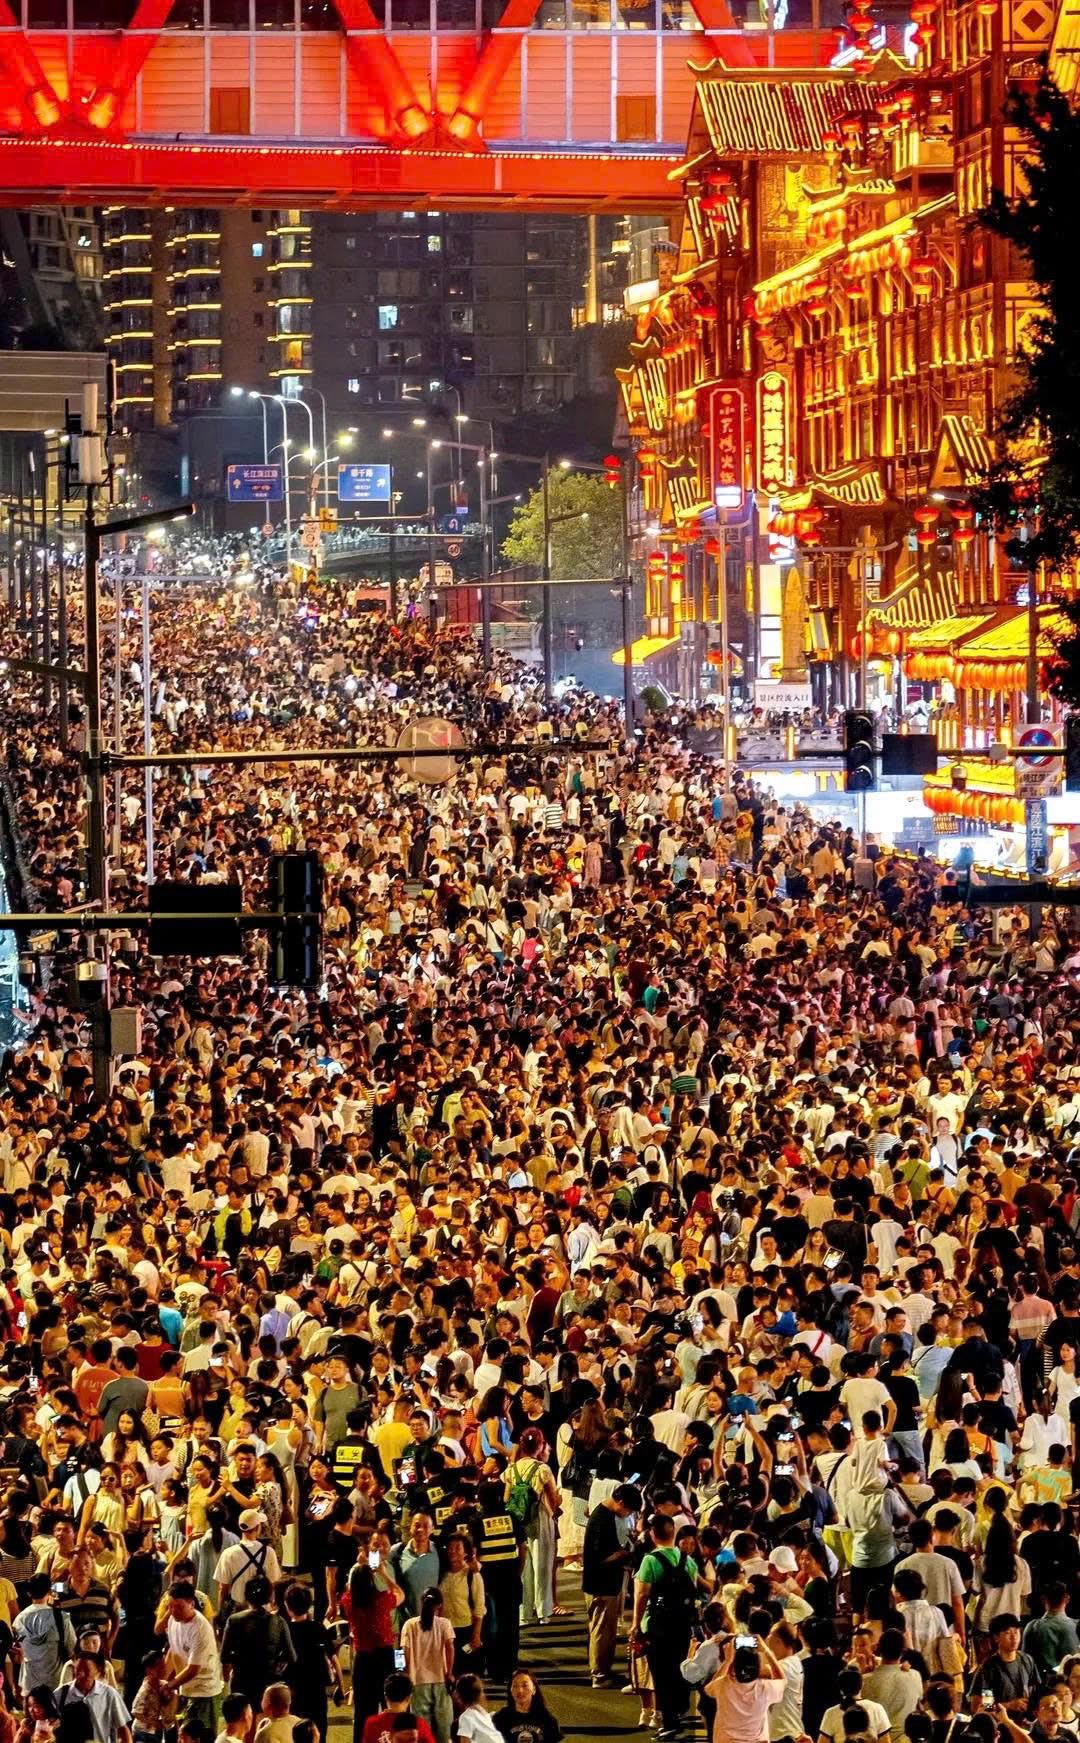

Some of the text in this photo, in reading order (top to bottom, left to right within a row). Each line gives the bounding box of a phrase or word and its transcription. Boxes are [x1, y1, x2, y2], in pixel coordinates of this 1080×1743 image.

[1031, 803, 1043, 867] 嘉陵江滨江
